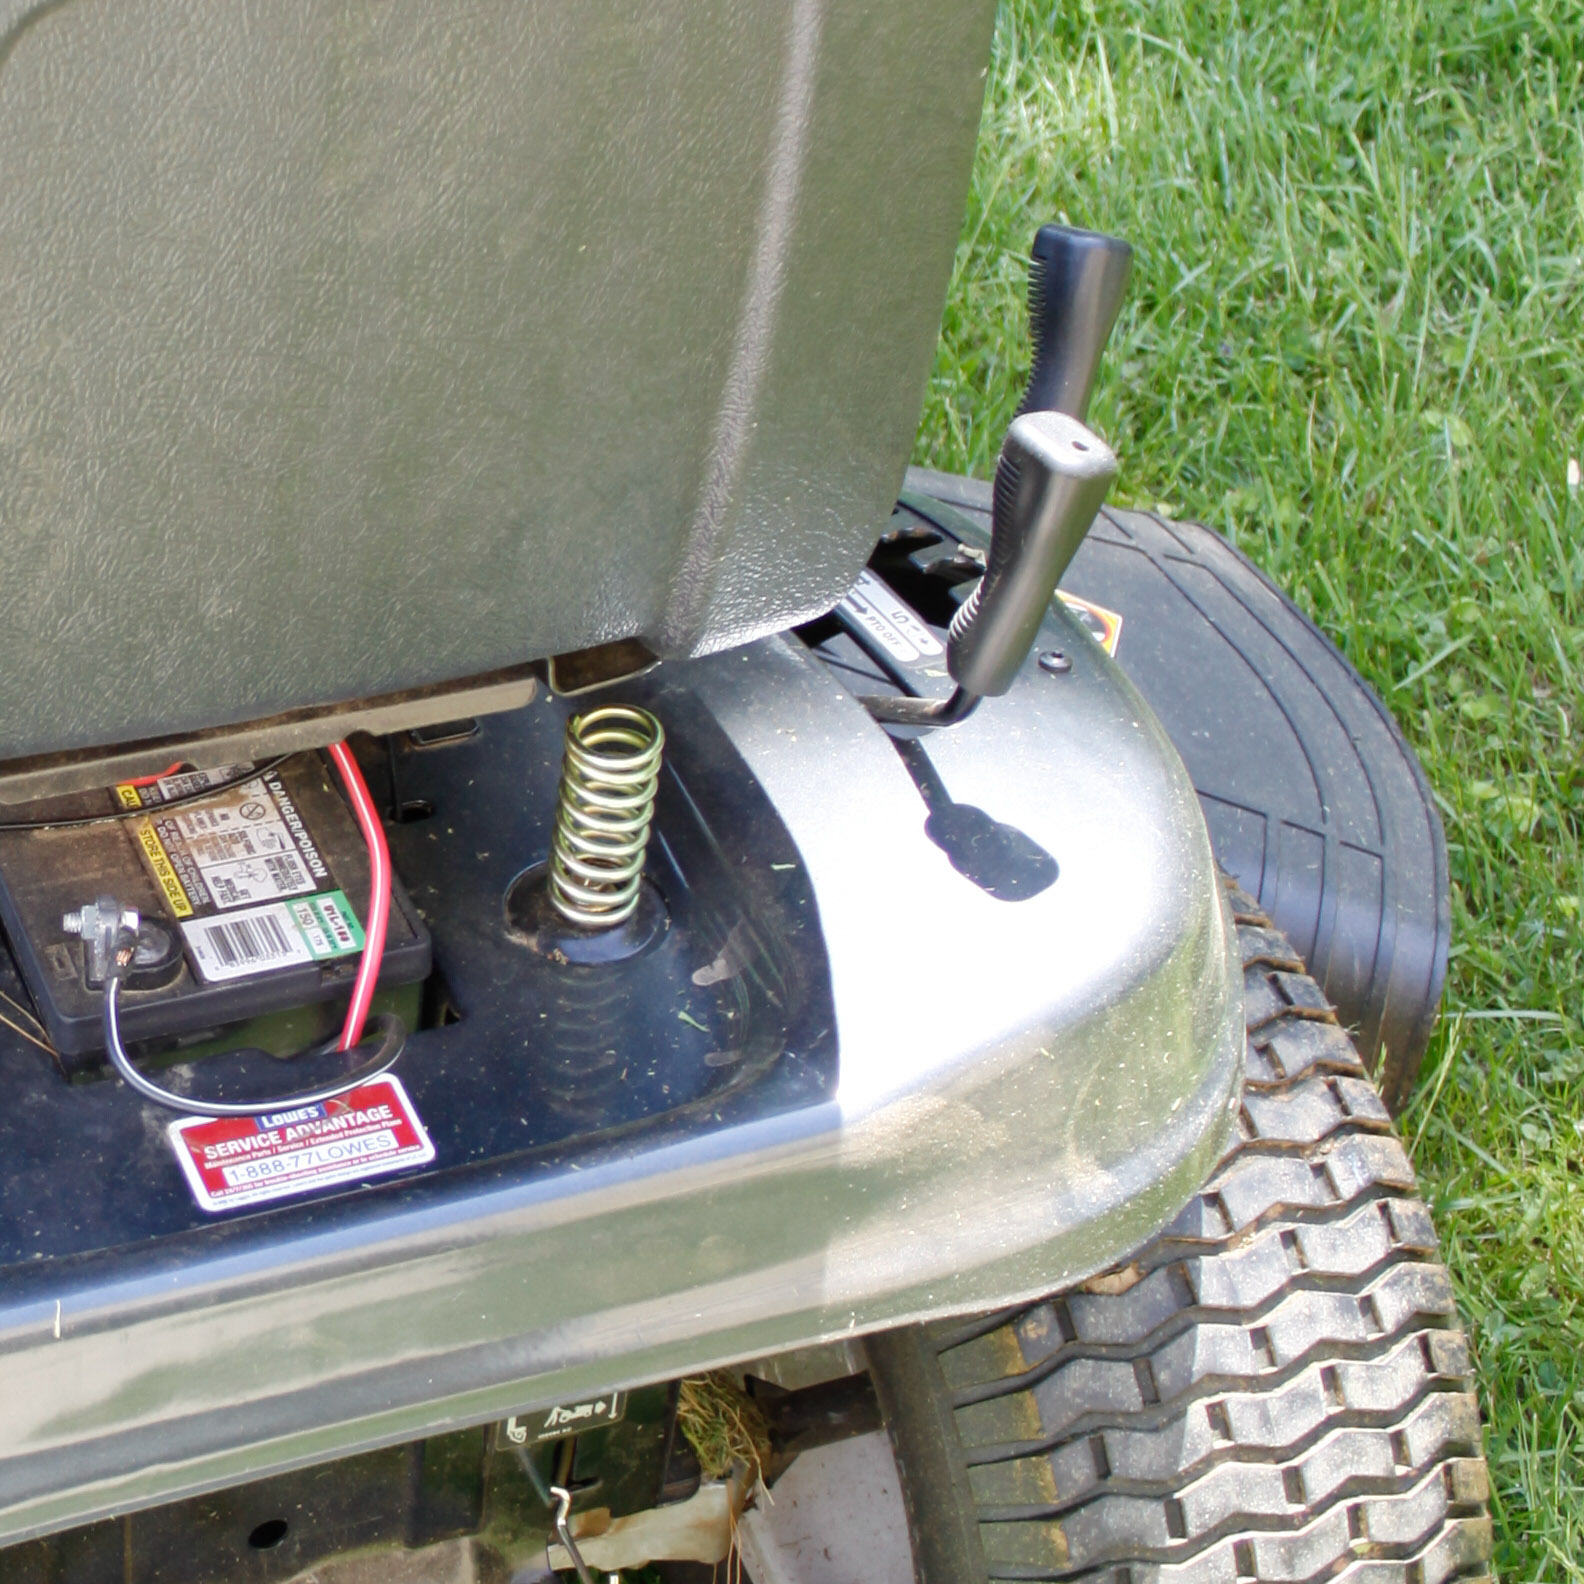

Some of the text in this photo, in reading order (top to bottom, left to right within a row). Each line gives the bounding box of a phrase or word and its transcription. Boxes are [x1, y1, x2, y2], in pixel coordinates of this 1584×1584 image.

[866, 615, 901, 646] PTO OFF
[269, 781, 328, 877] DANGER/POISON
[138, 829, 187, 911] STORE THIS SIDE UP
[169, 853, 186, 873] OPEN
[179, 873, 201, 905] BATTERY
[186, 867, 211, 903] CHILDREN
[296, 907, 315, 925] 150
[201, 1103, 394, 1160] SERVICE ADVANTAGE
[250, 1147, 272, 1158] Parts
[276, 1140, 305, 1152] Service
[308, 1131, 344, 1145] Extended
[343, 1122, 382, 1136] Protection
[380, 1117, 403, 1128] Plans
[228, 1134, 392, 1183] 1-888-77LOWES
